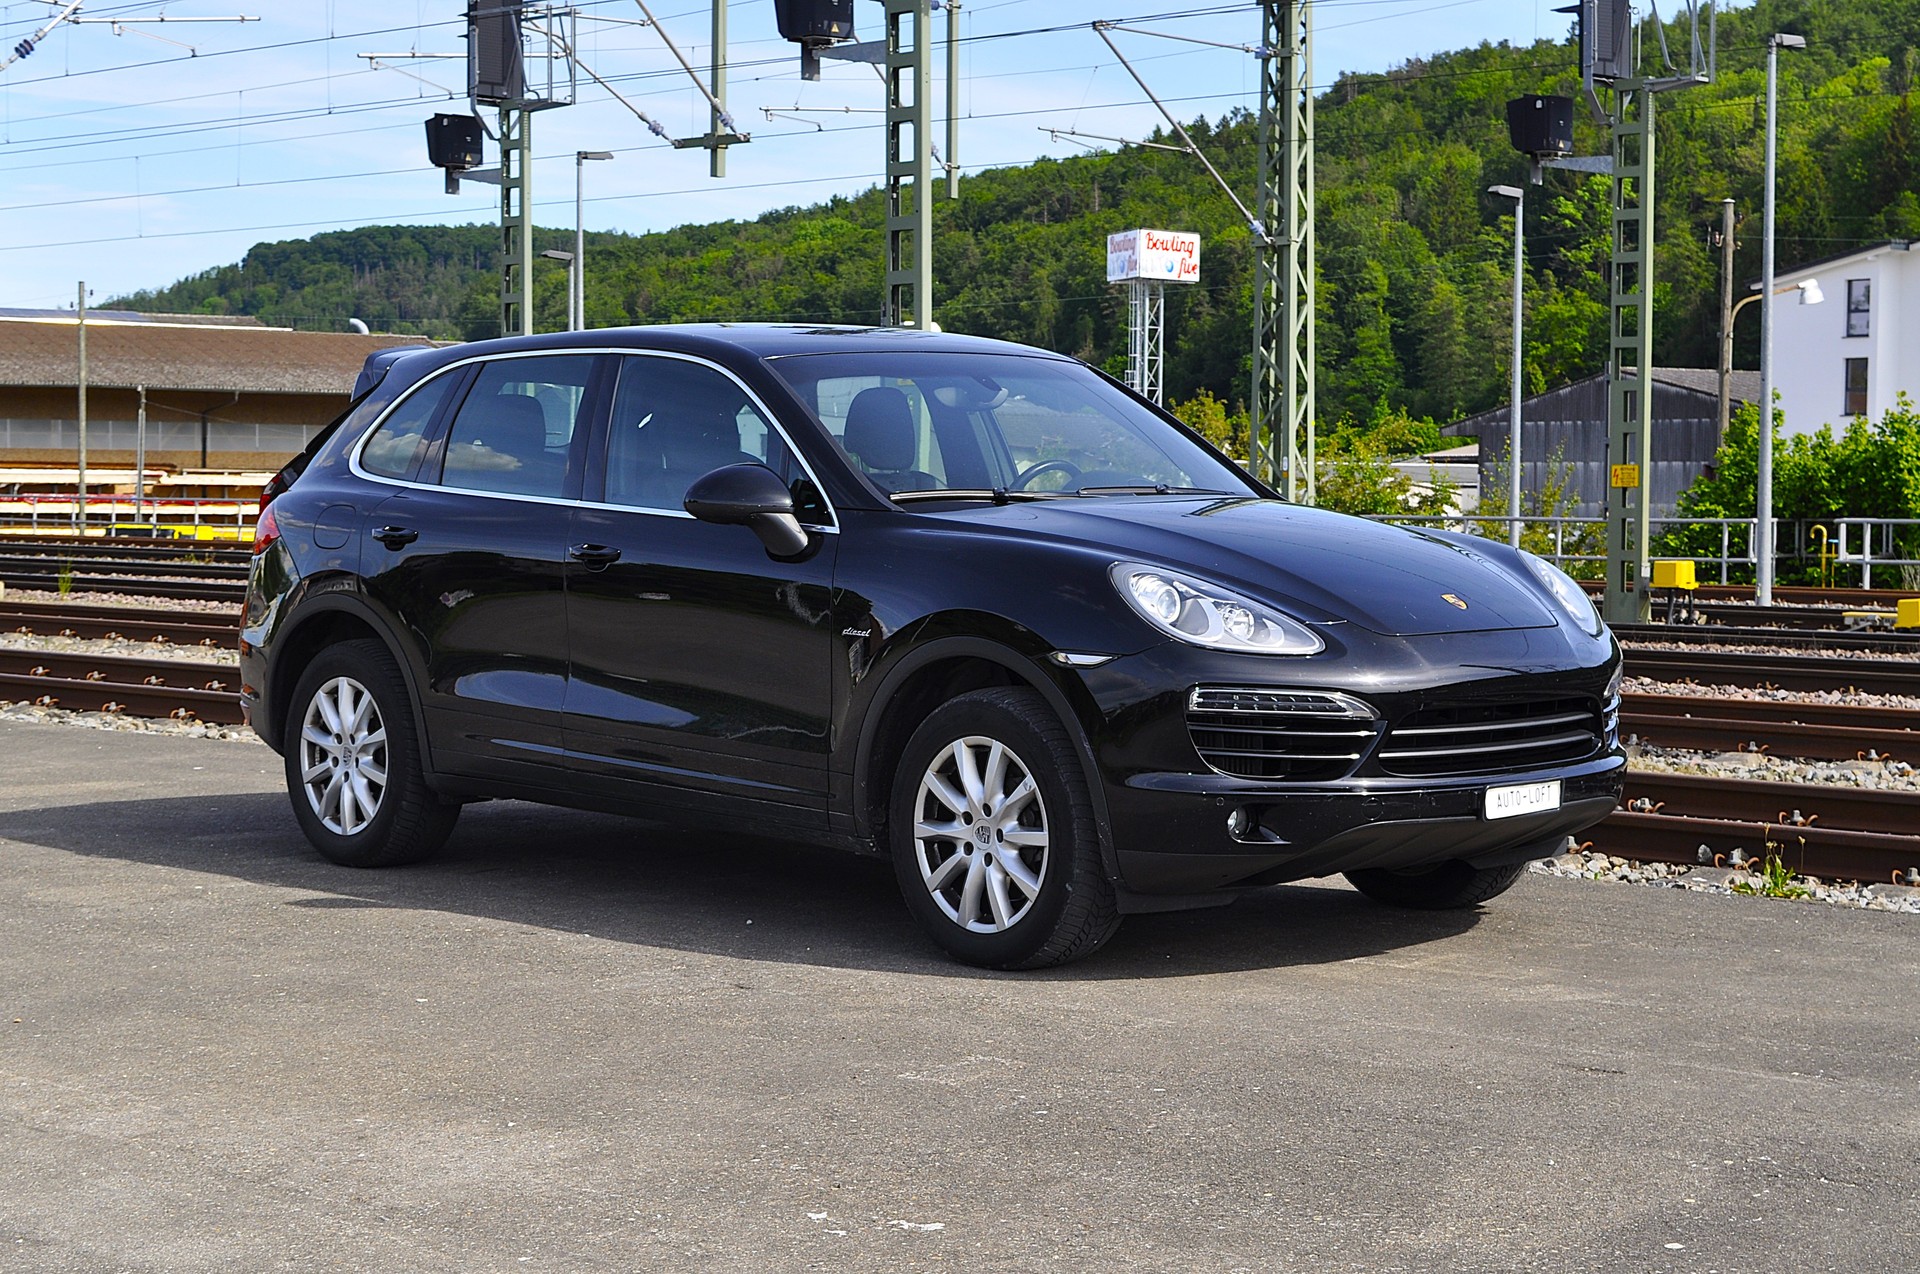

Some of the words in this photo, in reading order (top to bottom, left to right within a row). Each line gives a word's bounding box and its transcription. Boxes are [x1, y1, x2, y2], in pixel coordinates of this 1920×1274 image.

[1146, 232, 1195, 259] Bowling
[841, 626, 872, 637] diesel
[1497, 785, 1551, 808] AUTO-LOFT
